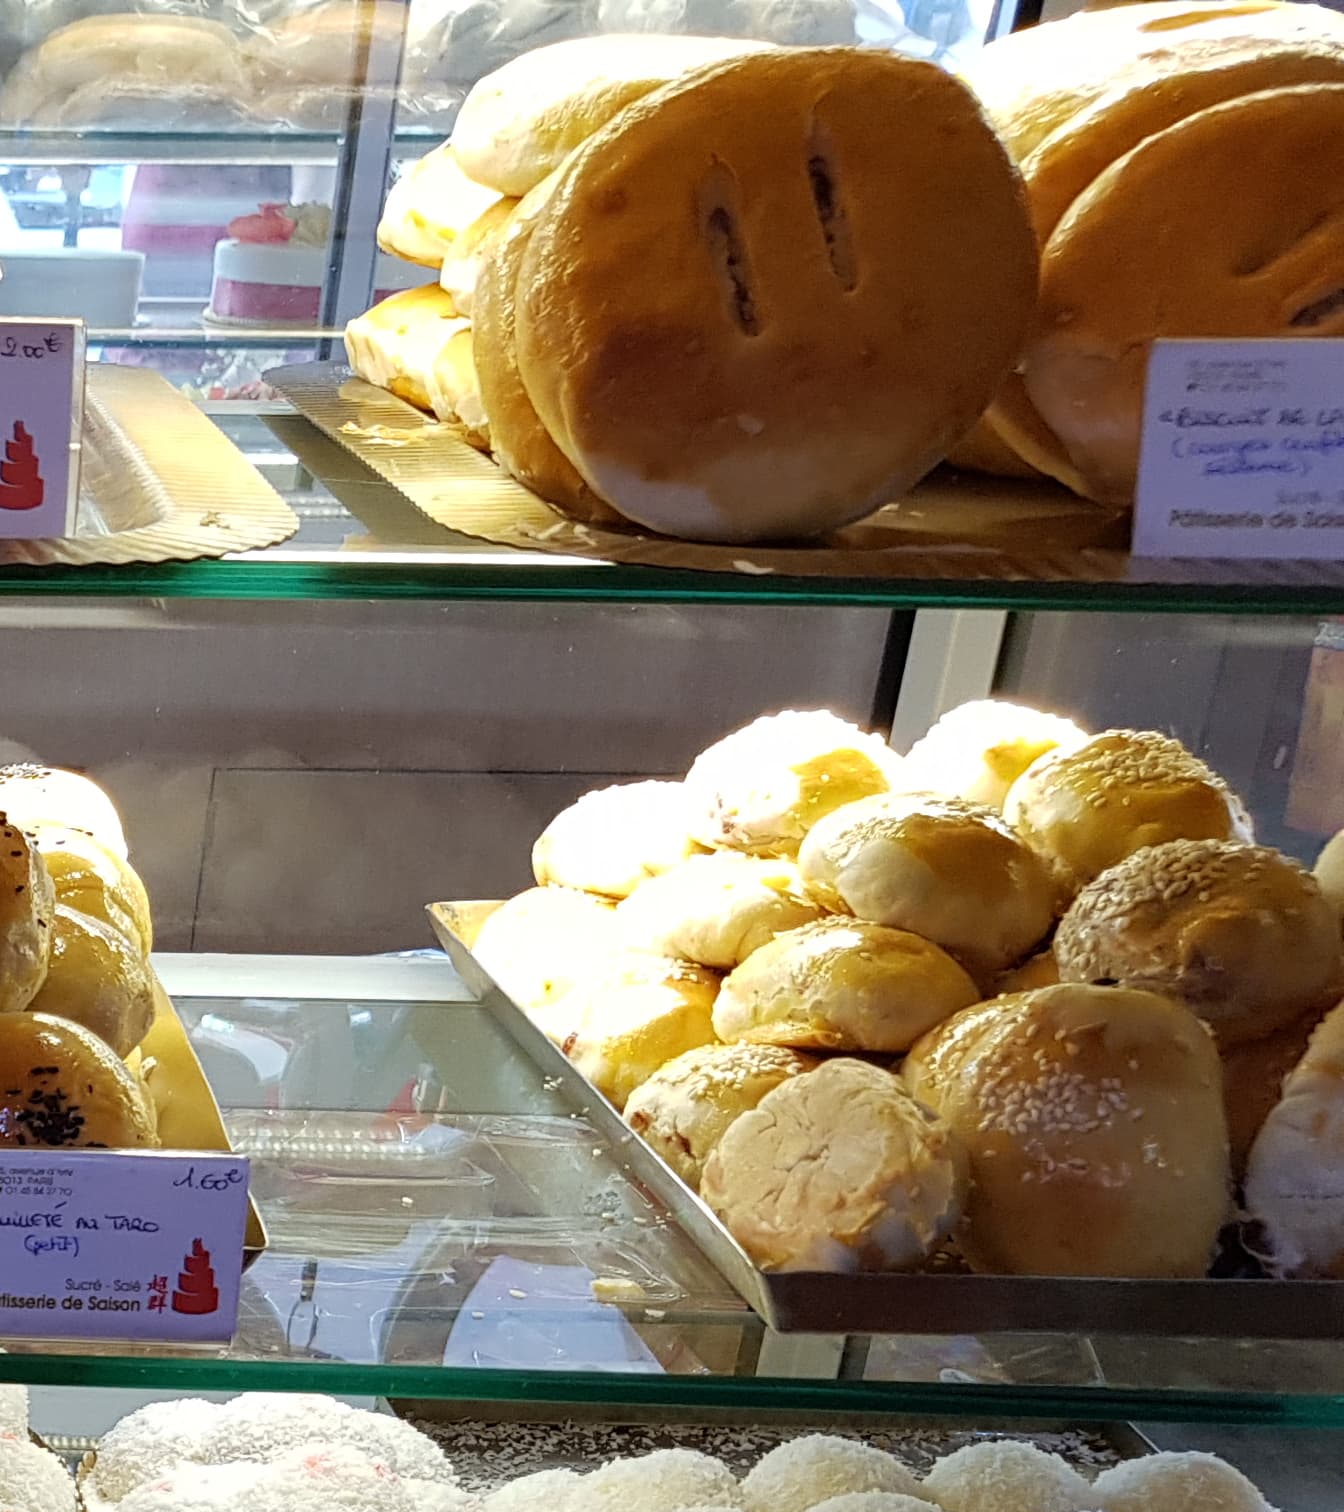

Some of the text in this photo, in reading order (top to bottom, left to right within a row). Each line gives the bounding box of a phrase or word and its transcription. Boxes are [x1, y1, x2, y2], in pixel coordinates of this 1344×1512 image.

[104, 1215, 160, 1233] TARO
[24, 1234, 80, 1258] (petit)
[65, 1279, 141, 1292] Sucré Salé
[61, 1296, 82, 1310] de
[88, 1297, 140, 1312] Saison
